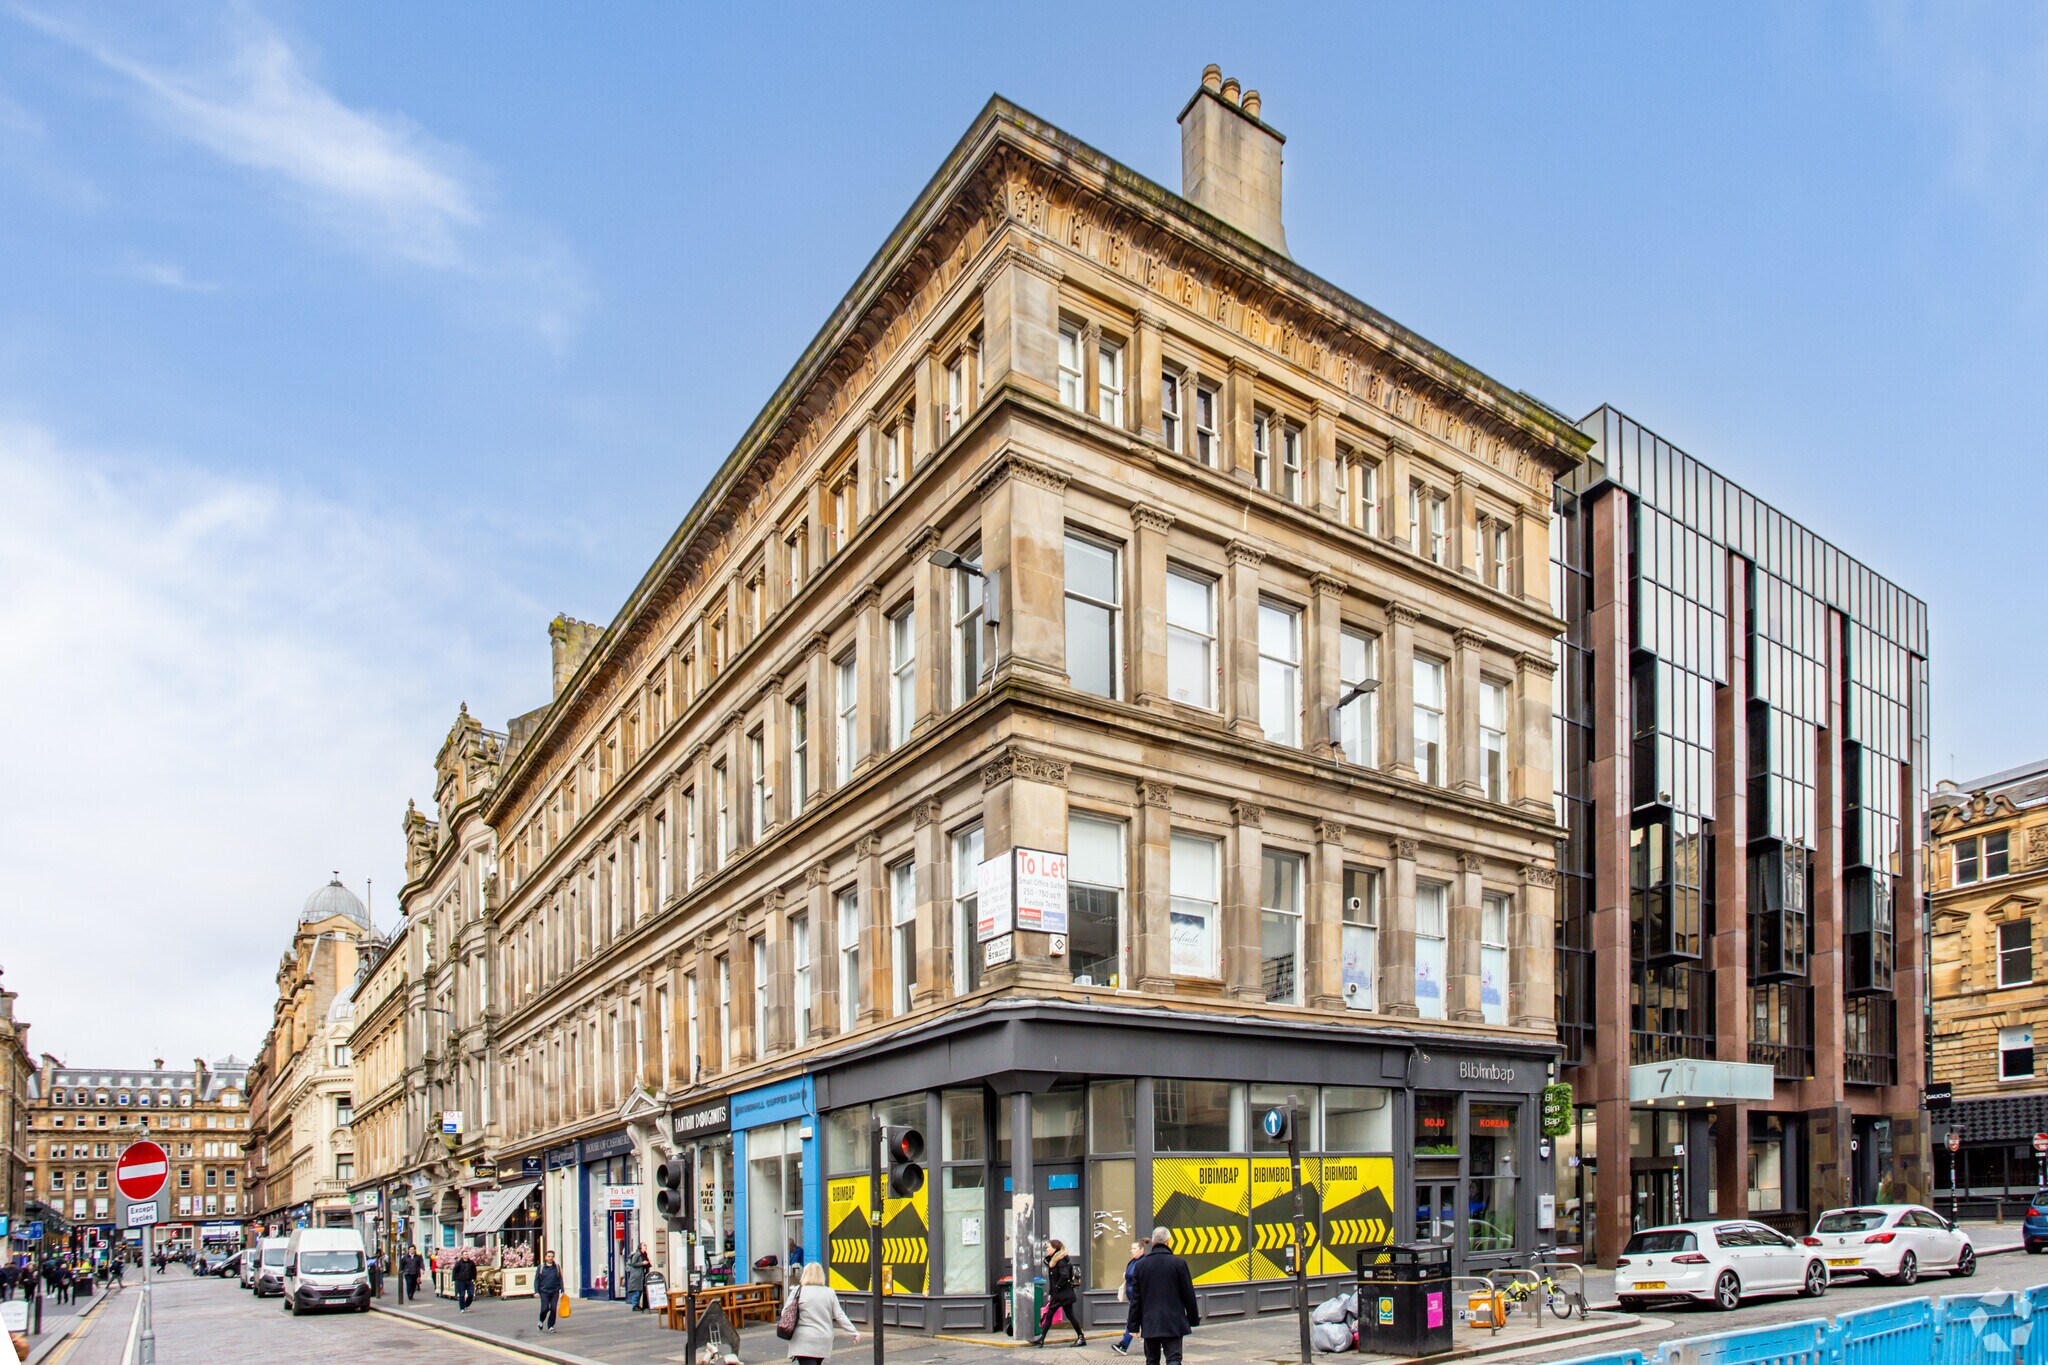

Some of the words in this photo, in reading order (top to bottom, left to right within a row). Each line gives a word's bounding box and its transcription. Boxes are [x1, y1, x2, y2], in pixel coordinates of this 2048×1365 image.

[1018, 851, 1036, 875] To
[1041, 855, 1065, 880] Let
[1018, 876, 1033, 886] Small
[1033, 879, 1049, 889] Office
[1050, 881, 1066, 891] Suites
[1023, 887, 1034, 896] 250
[1039, 889, 1049, 898] 750
[1657, 1068, 1673, 1093] 7
[1688, 1066, 1698, 1091] 7
[765, 1095, 788, 1108] COFFEE
[1925, 1092, 1951, 1100] GAUCHO
[695, 1105, 727, 1129] DOUGHNUTS
[1424, 1117, 1445, 1128] SOJU
[1479, 1119, 1509, 1129] KOREAN
[585, 1141, 600, 1154] HOUSE
[606, 1134, 631, 1149] CASHMERE
[1199, 1166, 1239, 1184] BIBIMBAP
[1253, 1166, 1290, 1183] BIBIMBBQ
[1324, 1165, 1358, 1182] BIBIMBBQ
[610, 1187, 619, 1195] To
[621, 1187, 634, 1195] Let
[833, 1185, 855, 1202] BIBIMBAP
[130, 1205, 154, 1215] Except
[131, 1214, 153, 1223] cycles
